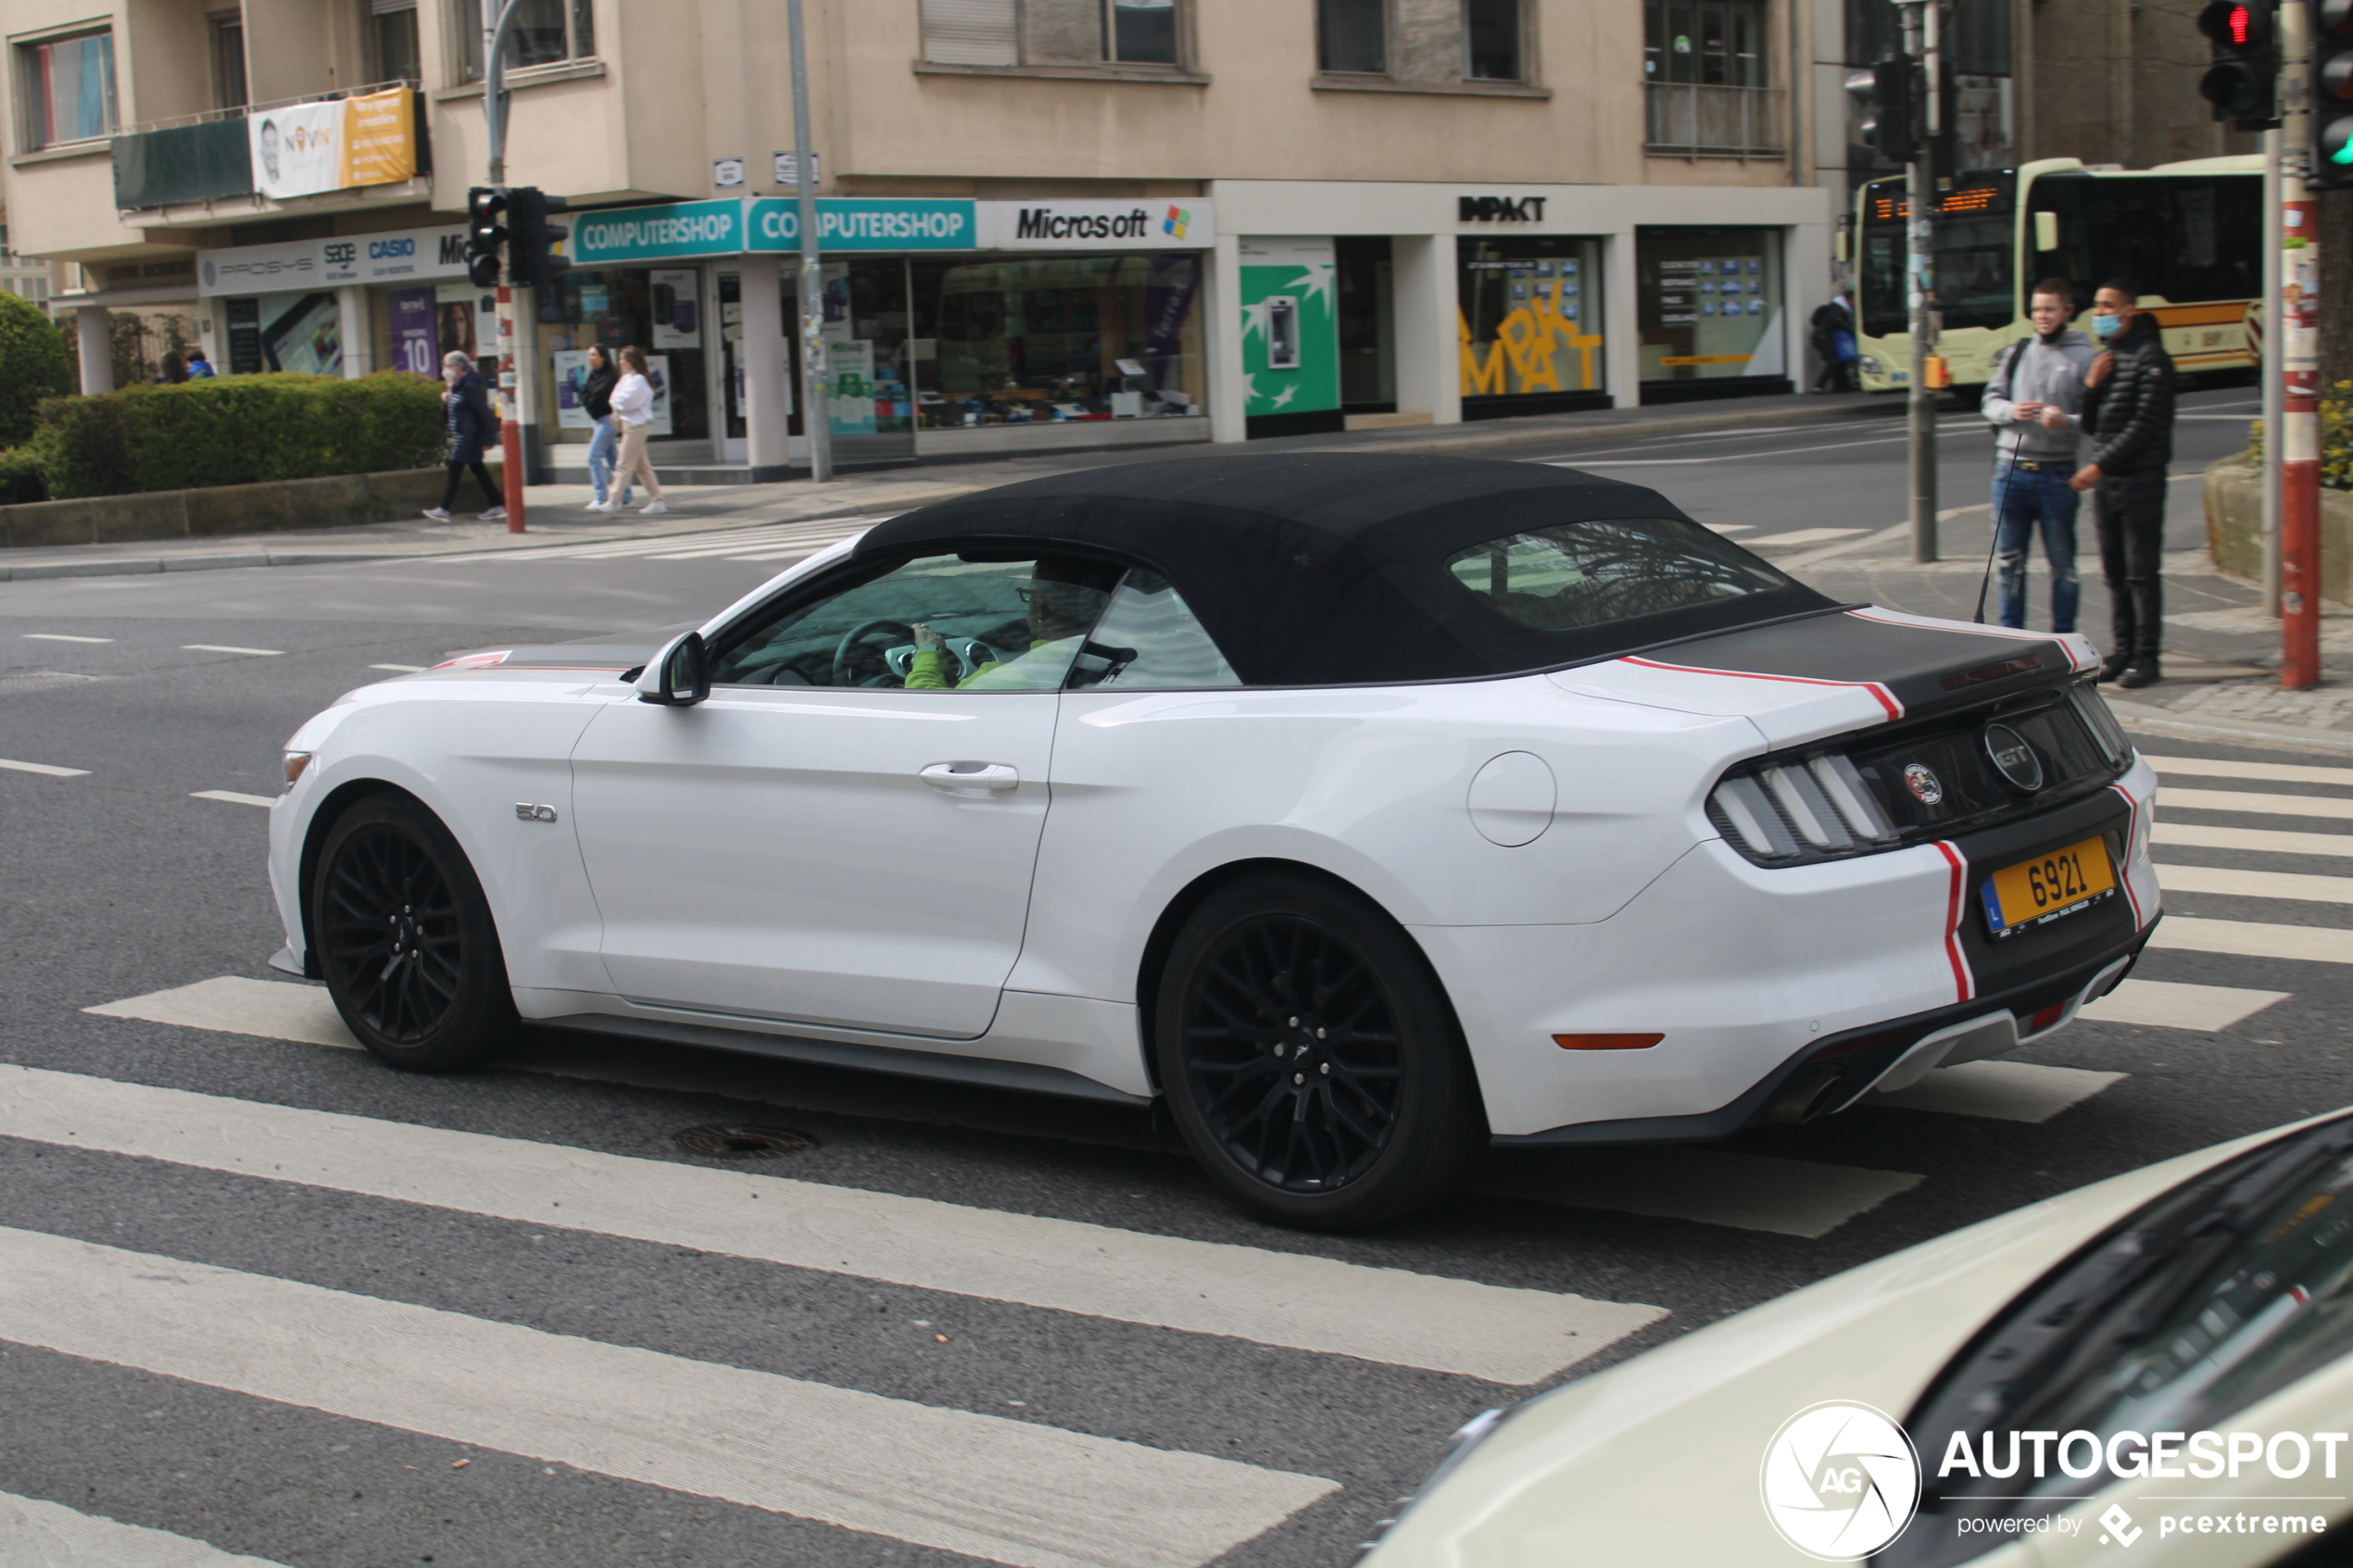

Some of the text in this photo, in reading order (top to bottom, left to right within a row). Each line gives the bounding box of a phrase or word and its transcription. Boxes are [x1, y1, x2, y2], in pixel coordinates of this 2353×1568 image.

[583, 213, 733, 250] COMPUTERSHOP
[1016, 208, 1148, 239] Microsoft
[324, 243, 356, 270] sage
[369, 238, 415, 259] CASIO
[220, 257, 313, 275] PROSYS
[403, 338, 431, 374] 10
[1996, 746, 2027, 768] GT
[2029, 851, 2087, 908] 6921
[1990, 908, 1999, 922] L
